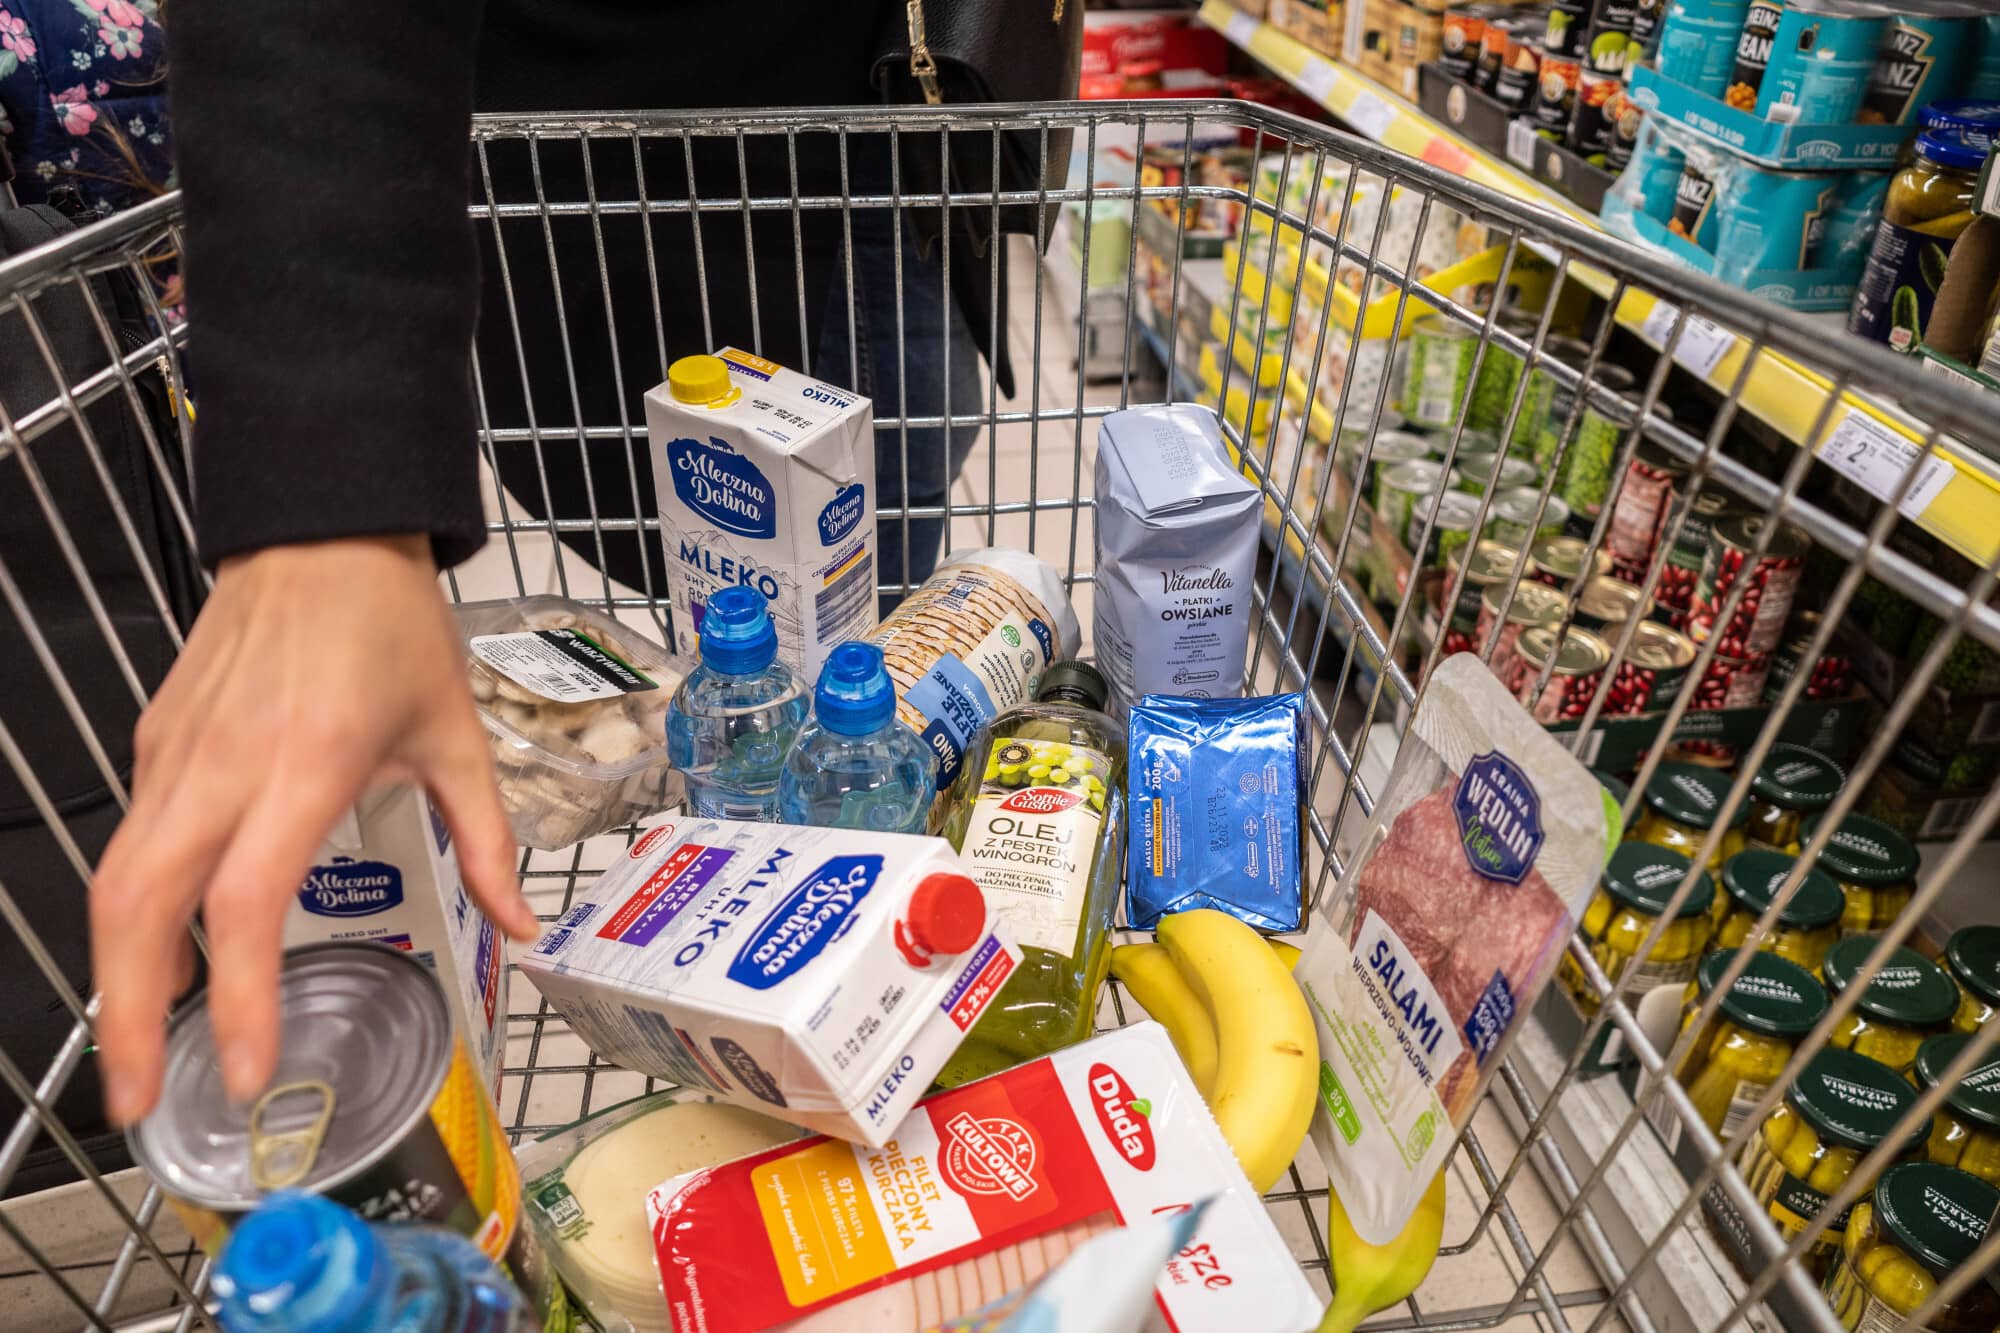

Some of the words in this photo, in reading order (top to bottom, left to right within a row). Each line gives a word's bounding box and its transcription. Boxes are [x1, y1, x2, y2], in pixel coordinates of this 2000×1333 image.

[802, 387, 850, 409] MLEKO
[1848, 441, 1868, 463] 2
[678, 450, 766, 505] Mleczna
[690, 476, 762, 523] Dolina
[822, 494, 861, 527] Mleczna
[828, 508, 858, 537] Dolina
[680, 540, 779, 600] MLEKO
[684, 573, 705, 589] UHT
[1160, 568, 1235, 594] Vitanella
[1161, 604, 1233, 621] OWSIANE
[569, 671, 591, 687] 200
[932, 732, 958, 772] PANO
[1009, 797, 1053, 812] Gusto
[1023, 787, 1069, 807] Sottile
[1489, 767, 1530, 818] KRAINA
[988, 817, 1073, 845] OLEJ
[1467, 773, 1533, 863] WĘDLIN
[972, 848, 1076, 873] WINOGRON
[984, 837, 997, 848] Z
[1000, 839, 1068, 858] PESTEK
[301, 872, 392, 891] Mleczna
[642, 851, 693, 896] 3,2%
[973, 877, 1021, 889] SMAŻENIA
[1028, 884, 1063, 897] GRILLA
[1003, 872, 1054, 888] PIECZENIA,
[316, 888, 388, 909] Dolina
[668, 883, 700, 911] BEZ
[674, 848, 793, 967] MLEKO
[696, 887, 732, 920] UHT
[330, 929, 367, 940] MLEKO
[367, 927, 388, 937] UHT
[752, 877, 839, 966] Dolina
[763, 863, 867, 977] Mleczna
[956, 983, 990, 1024] 3,2%
[1369, 940, 1445, 1056] SALAMI
[1352, 955, 1434, 1089] WIEPRZOWO-WOŁOWE
[866, 1054, 915, 1120] MLEKO
[1822, 1077, 1899, 1105] SPIŻARNIA
[1092, 1072, 1145, 1159] Duda
[1330, 1089, 1342, 1106] 80
[1336, 1107, 1346, 1119] g
[999, 1123, 1031, 1154] TAK
[953, 1118, 1030, 1194] KULTOWE
[883, 1140, 933, 1232] PIECZONY
[909, 1155, 941, 1202] FILET
[821, 1177, 837, 1206] PIERSI
[831, 1206, 855, 1259] KURCZAKA
[836, 1176, 854, 1193] 97
[848, 1208, 865, 1239] FILETA
[868, 1155, 915, 1251] KURCZAKA
[1931, 1207, 1979, 1240] NASZA
